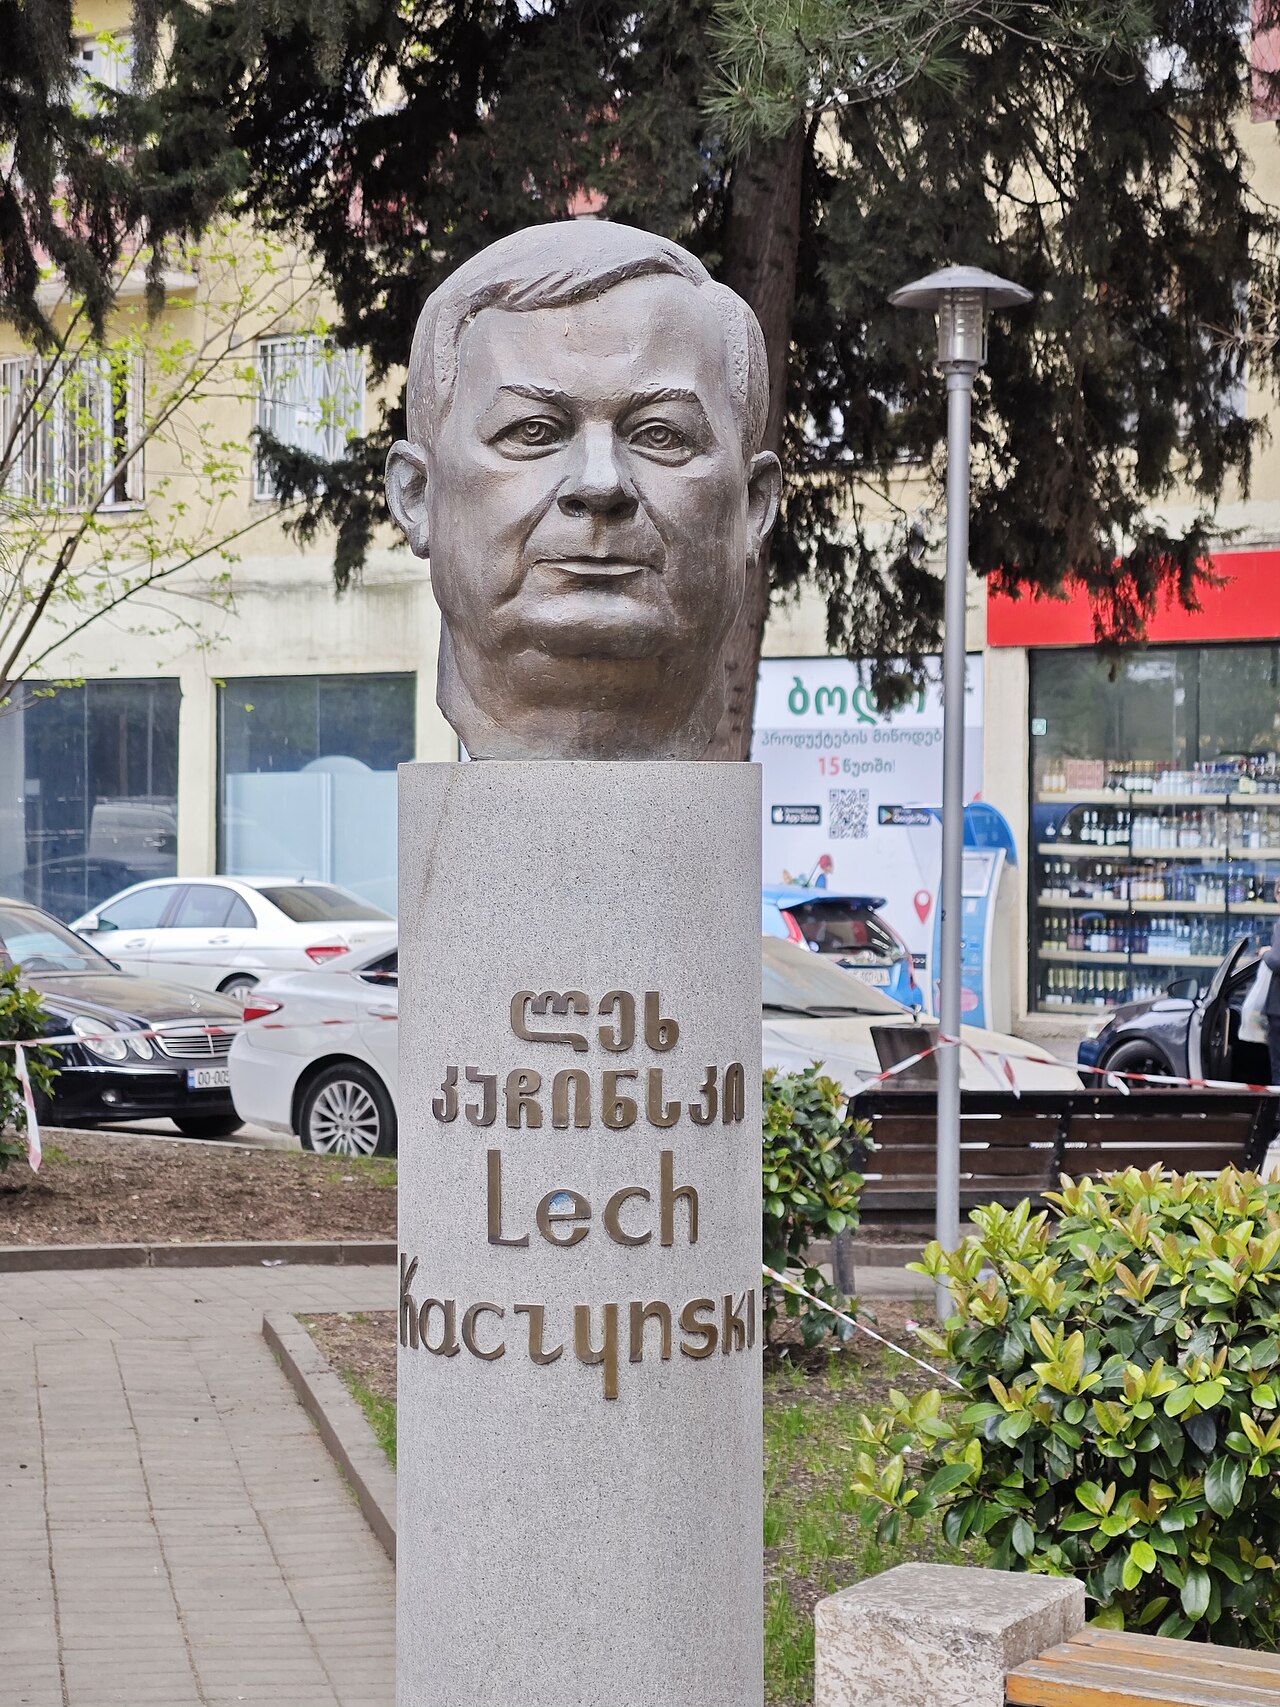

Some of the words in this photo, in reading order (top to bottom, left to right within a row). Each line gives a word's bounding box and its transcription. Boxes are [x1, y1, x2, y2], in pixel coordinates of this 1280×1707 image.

[761, 729, 868, 749] პროდუქტების
[872, 729, 942, 746] მიწოდებ
[818, 757, 840, 776] 15
[510, 989, 680, 1052] ლეხ
[486, 1148, 699, 1247] Lech
